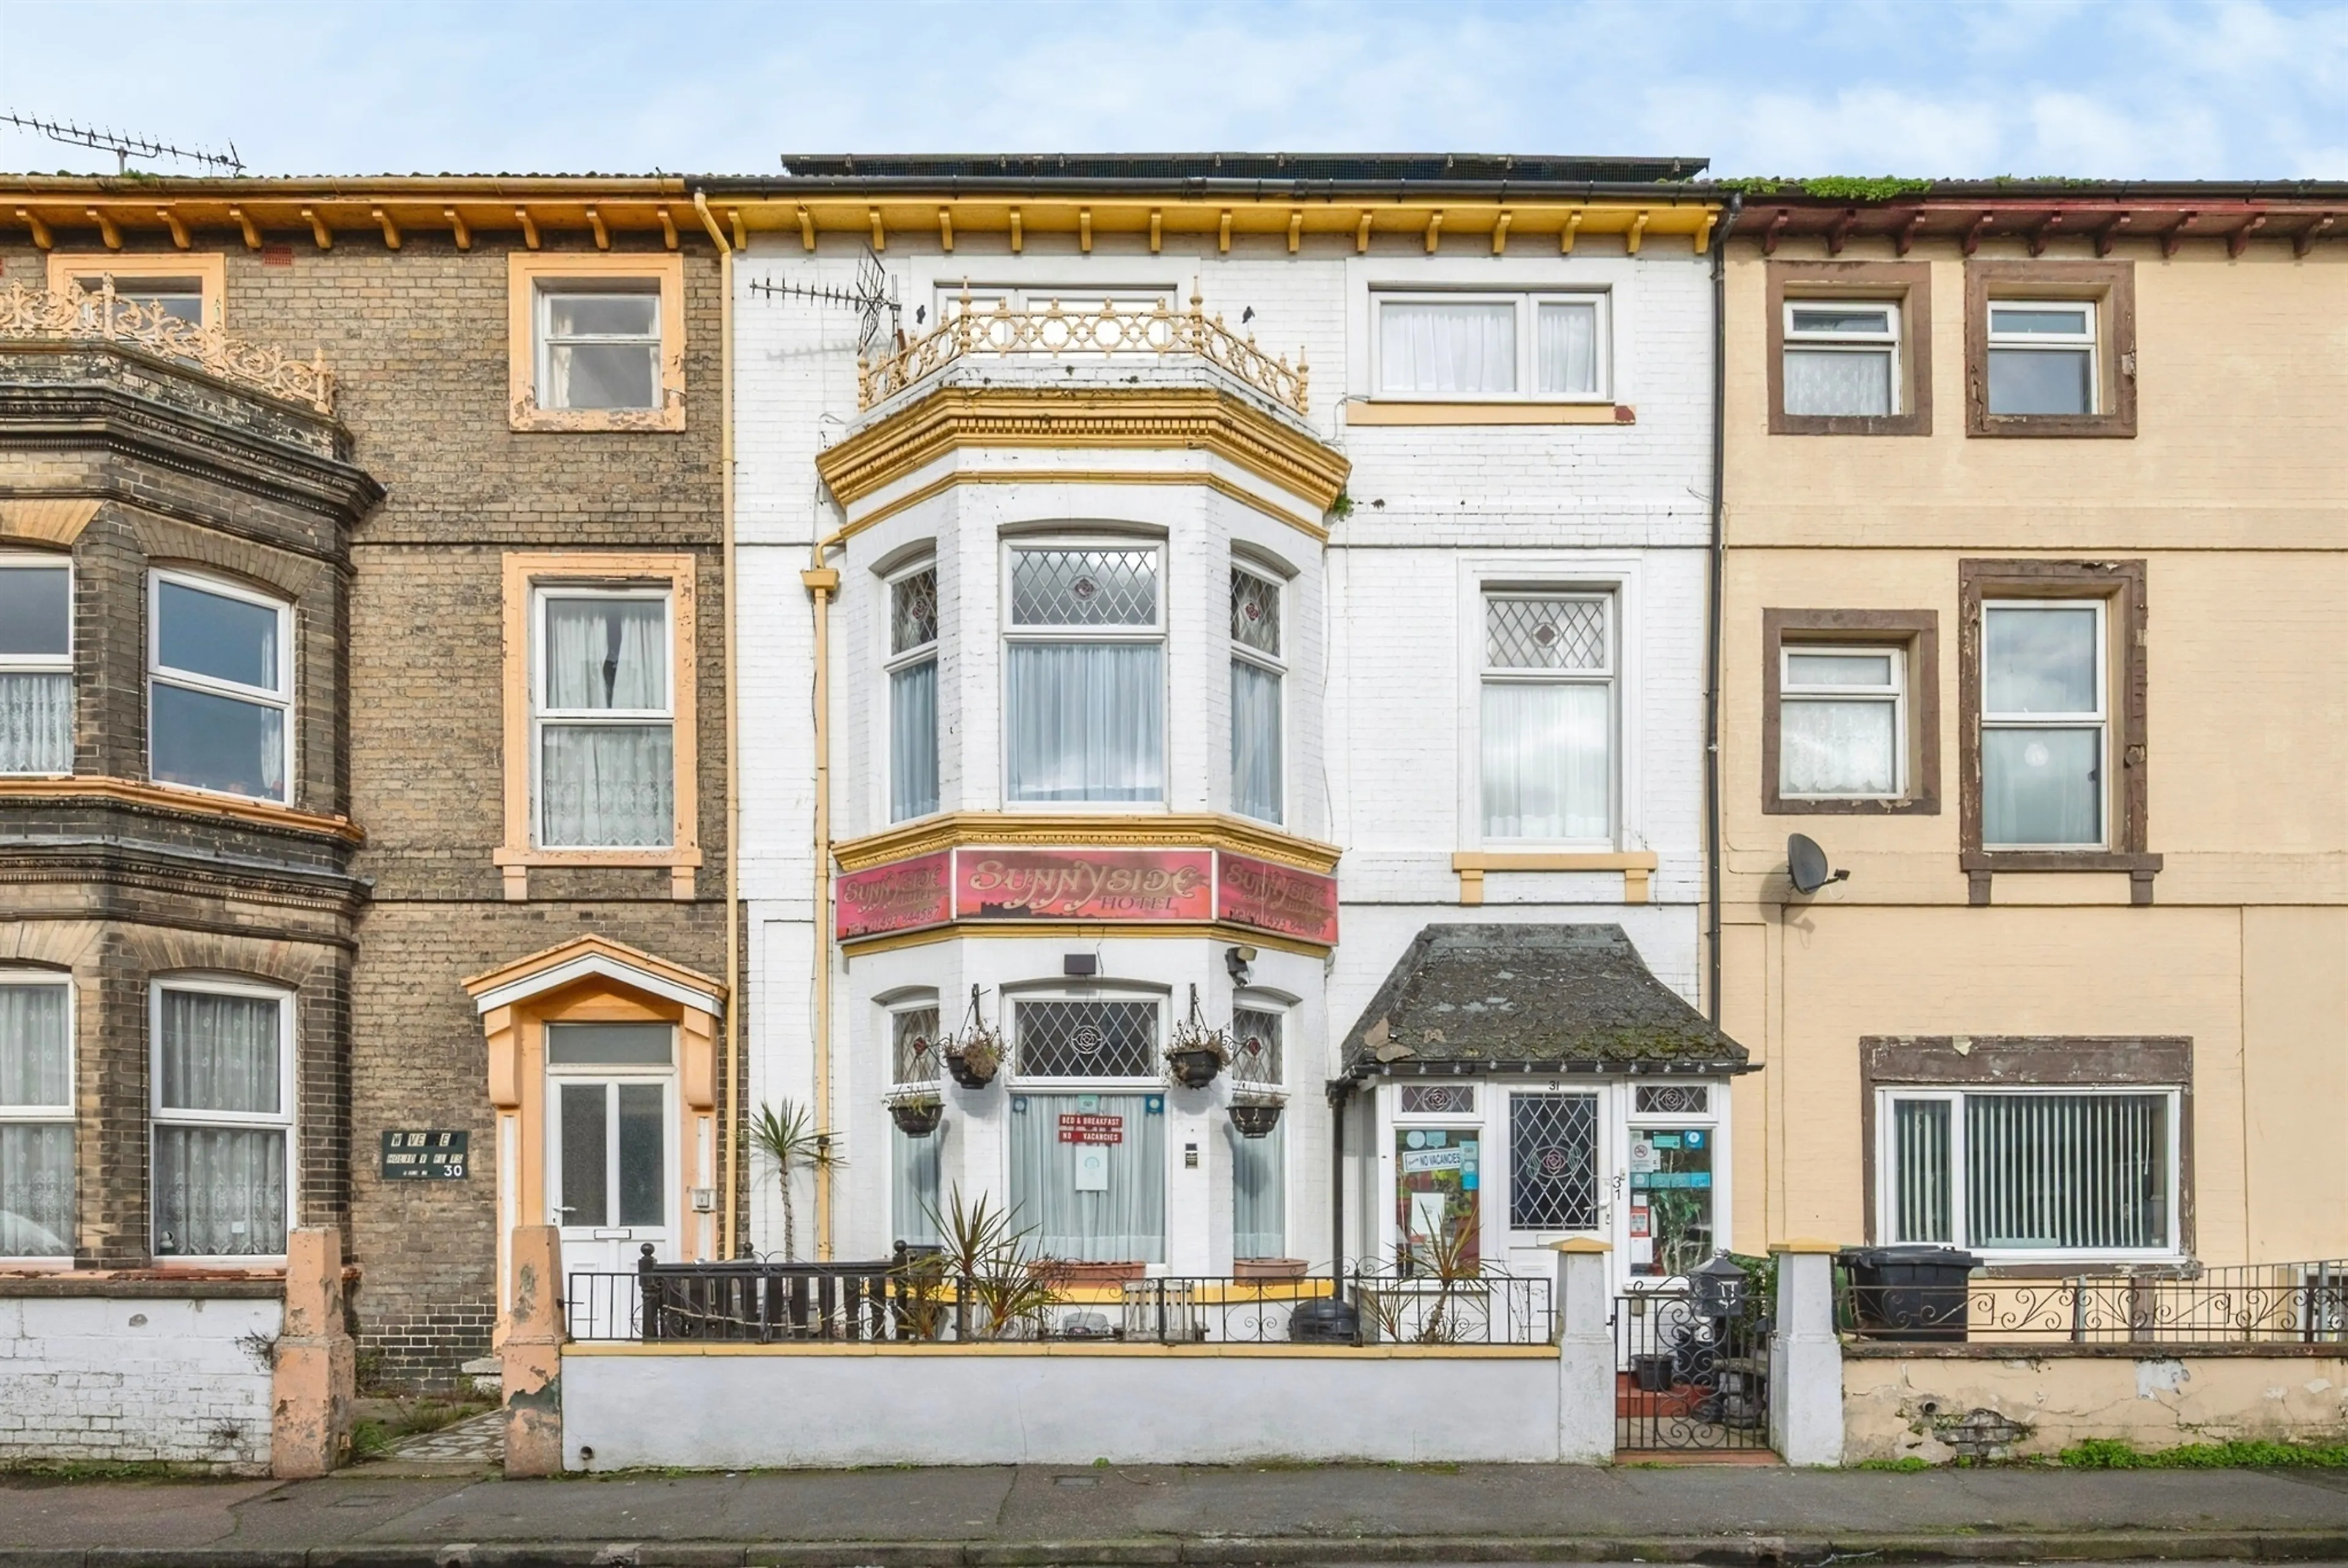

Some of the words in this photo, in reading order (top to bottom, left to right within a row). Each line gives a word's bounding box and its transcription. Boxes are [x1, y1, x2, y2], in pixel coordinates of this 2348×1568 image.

[1101, 896, 1175, 911] HOTEL
[1549, 1081, 1559, 1091] 31
[1062, 1116, 1075, 1124] BED
[1083, 1117, 1120, 1126] BREAKFAST
[1083, 1133, 1118, 1141] VACANCIES
[1419, 1155, 1428, 1166] NO
[444, 1165, 463, 1177] 30
